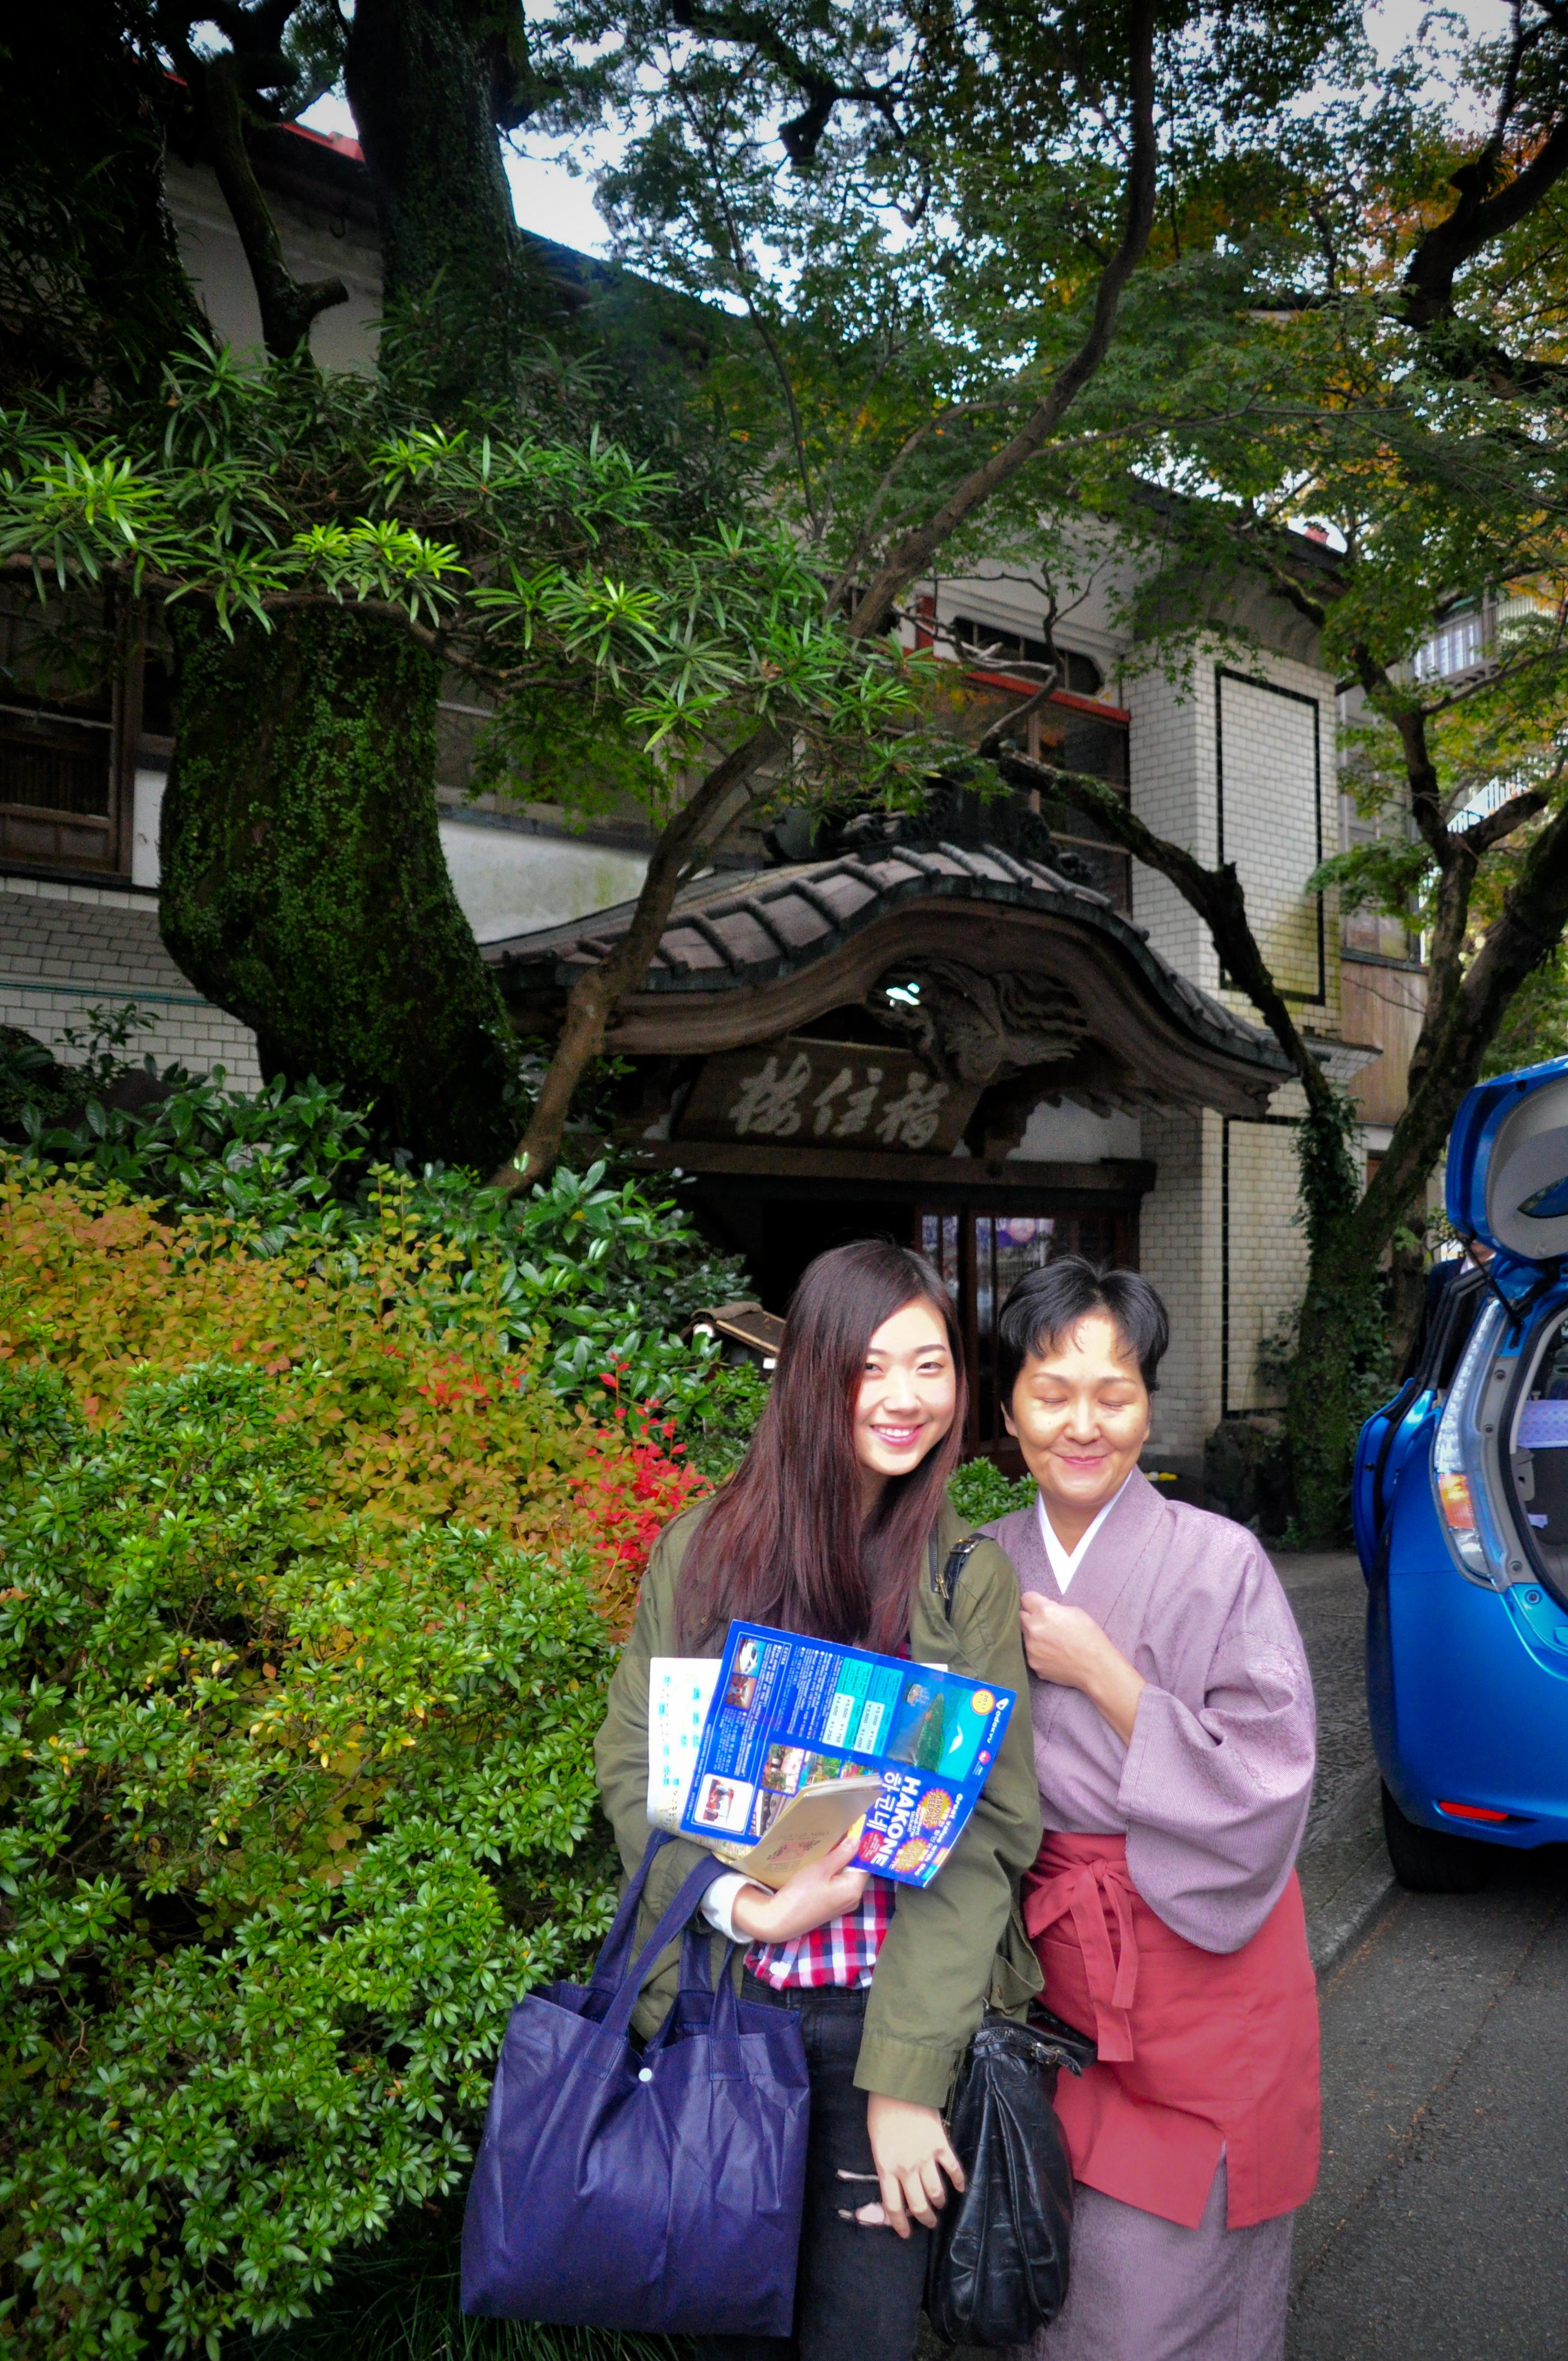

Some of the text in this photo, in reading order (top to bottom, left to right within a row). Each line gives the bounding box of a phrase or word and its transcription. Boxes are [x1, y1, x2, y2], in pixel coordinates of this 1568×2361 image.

[780, 1647, 788, 1665] EXTRA
[865, 1770, 904, 1832] 하코네
[869, 1776, 921, 1867] HAKONE
